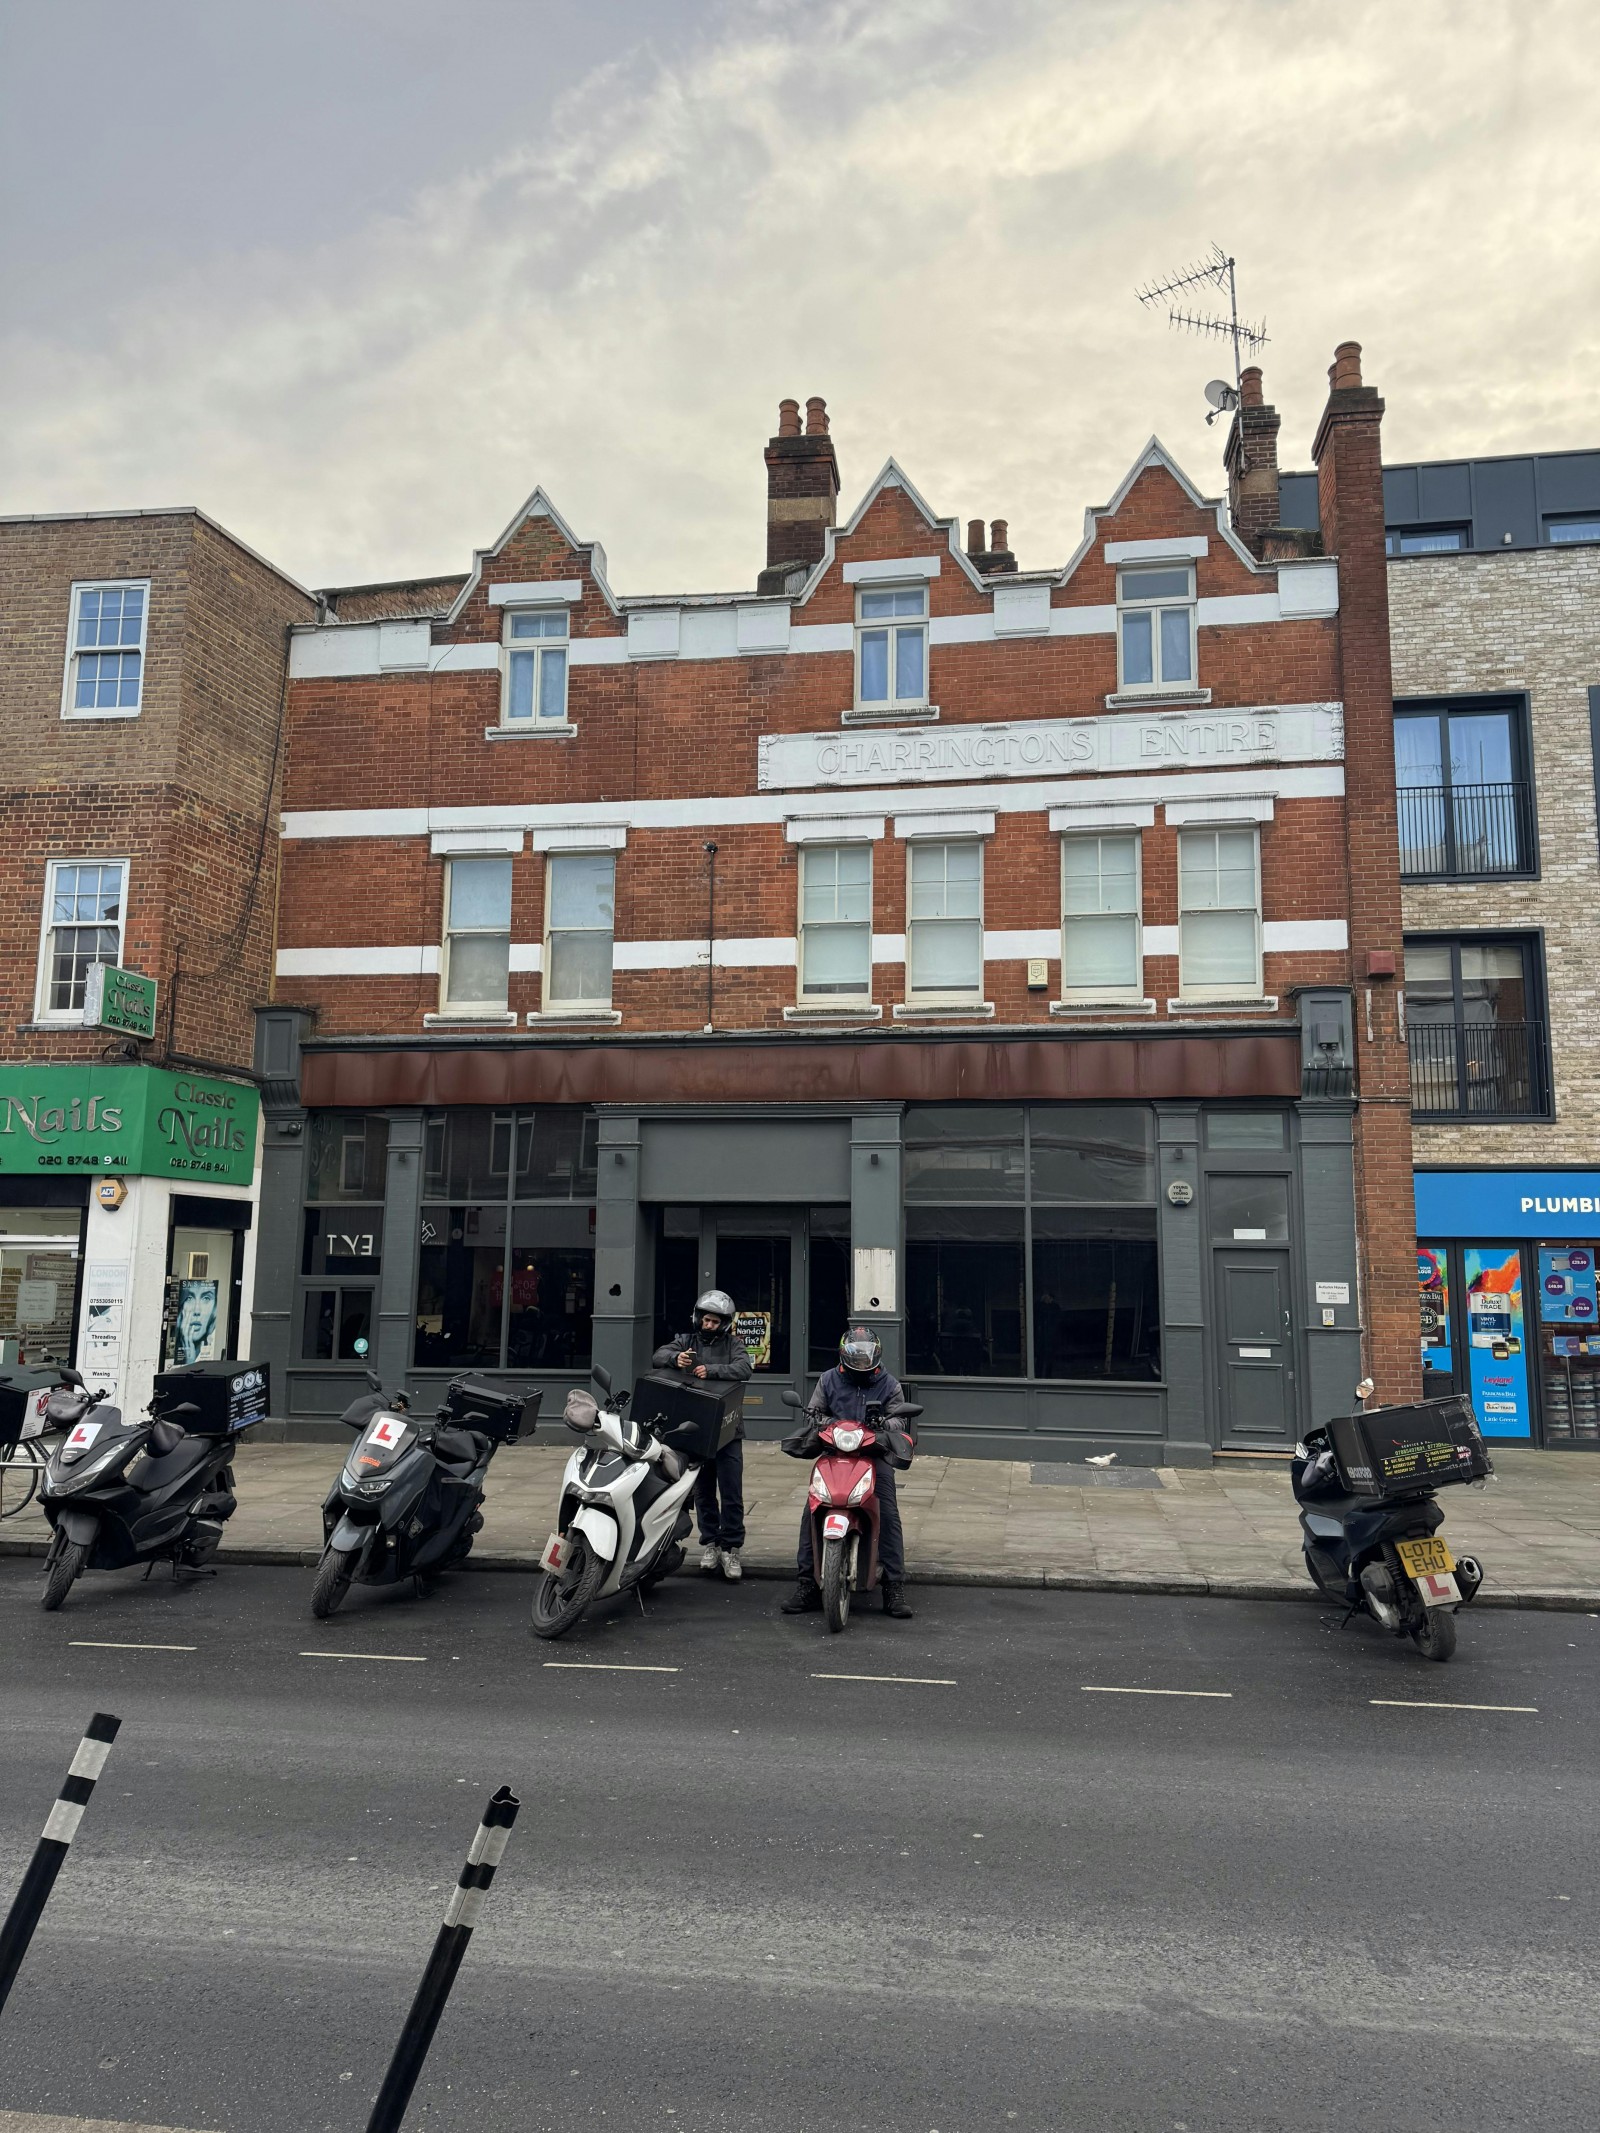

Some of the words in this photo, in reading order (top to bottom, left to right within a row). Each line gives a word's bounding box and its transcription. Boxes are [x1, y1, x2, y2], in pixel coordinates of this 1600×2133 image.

[816, 730, 1094, 775] CHARRINGTONS
[1139, 720, 1277, 758] ENTIRE
[116, 975, 146, 994] Classic
[108, 989, 151, 1019] Nails
[174, 1081, 236, 1110] Classic
[0, 1095, 122, 1144] Nails
[158, 1107, 246, 1158] Nails
[38, 1155, 62, 1166] 020
[67, 1155, 99, 1166] 8748
[103, 1155, 128, 1166] 9411
[170, 1157, 187, 1168] 020
[189, 1160, 212, 1172] 8748
[213, 1163, 230, 1173] 9411
[101, 1188, 114, 1197] ADT
[1521, 1197, 1600, 1213] PLUMBI
[91, 1269, 126, 1278] LONDON
[757, 1318, 764, 1326] a
[736, 1327, 765, 1335] Nando's
[744, 1336, 760, 1345] fix?
[1483, 1375, 1514, 1384] Leyland
[71, 1428, 87, 1442] L
[376, 1424, 392, 1441] L
[827, 1516, 843, 1530] L
[547, 1543, 561, 1568] L
[1401, 1540, 1446, 1558] LO73
[1412, 1555, 1446, 1572] EHU
[1425, 1575, 1451, 1597] L
